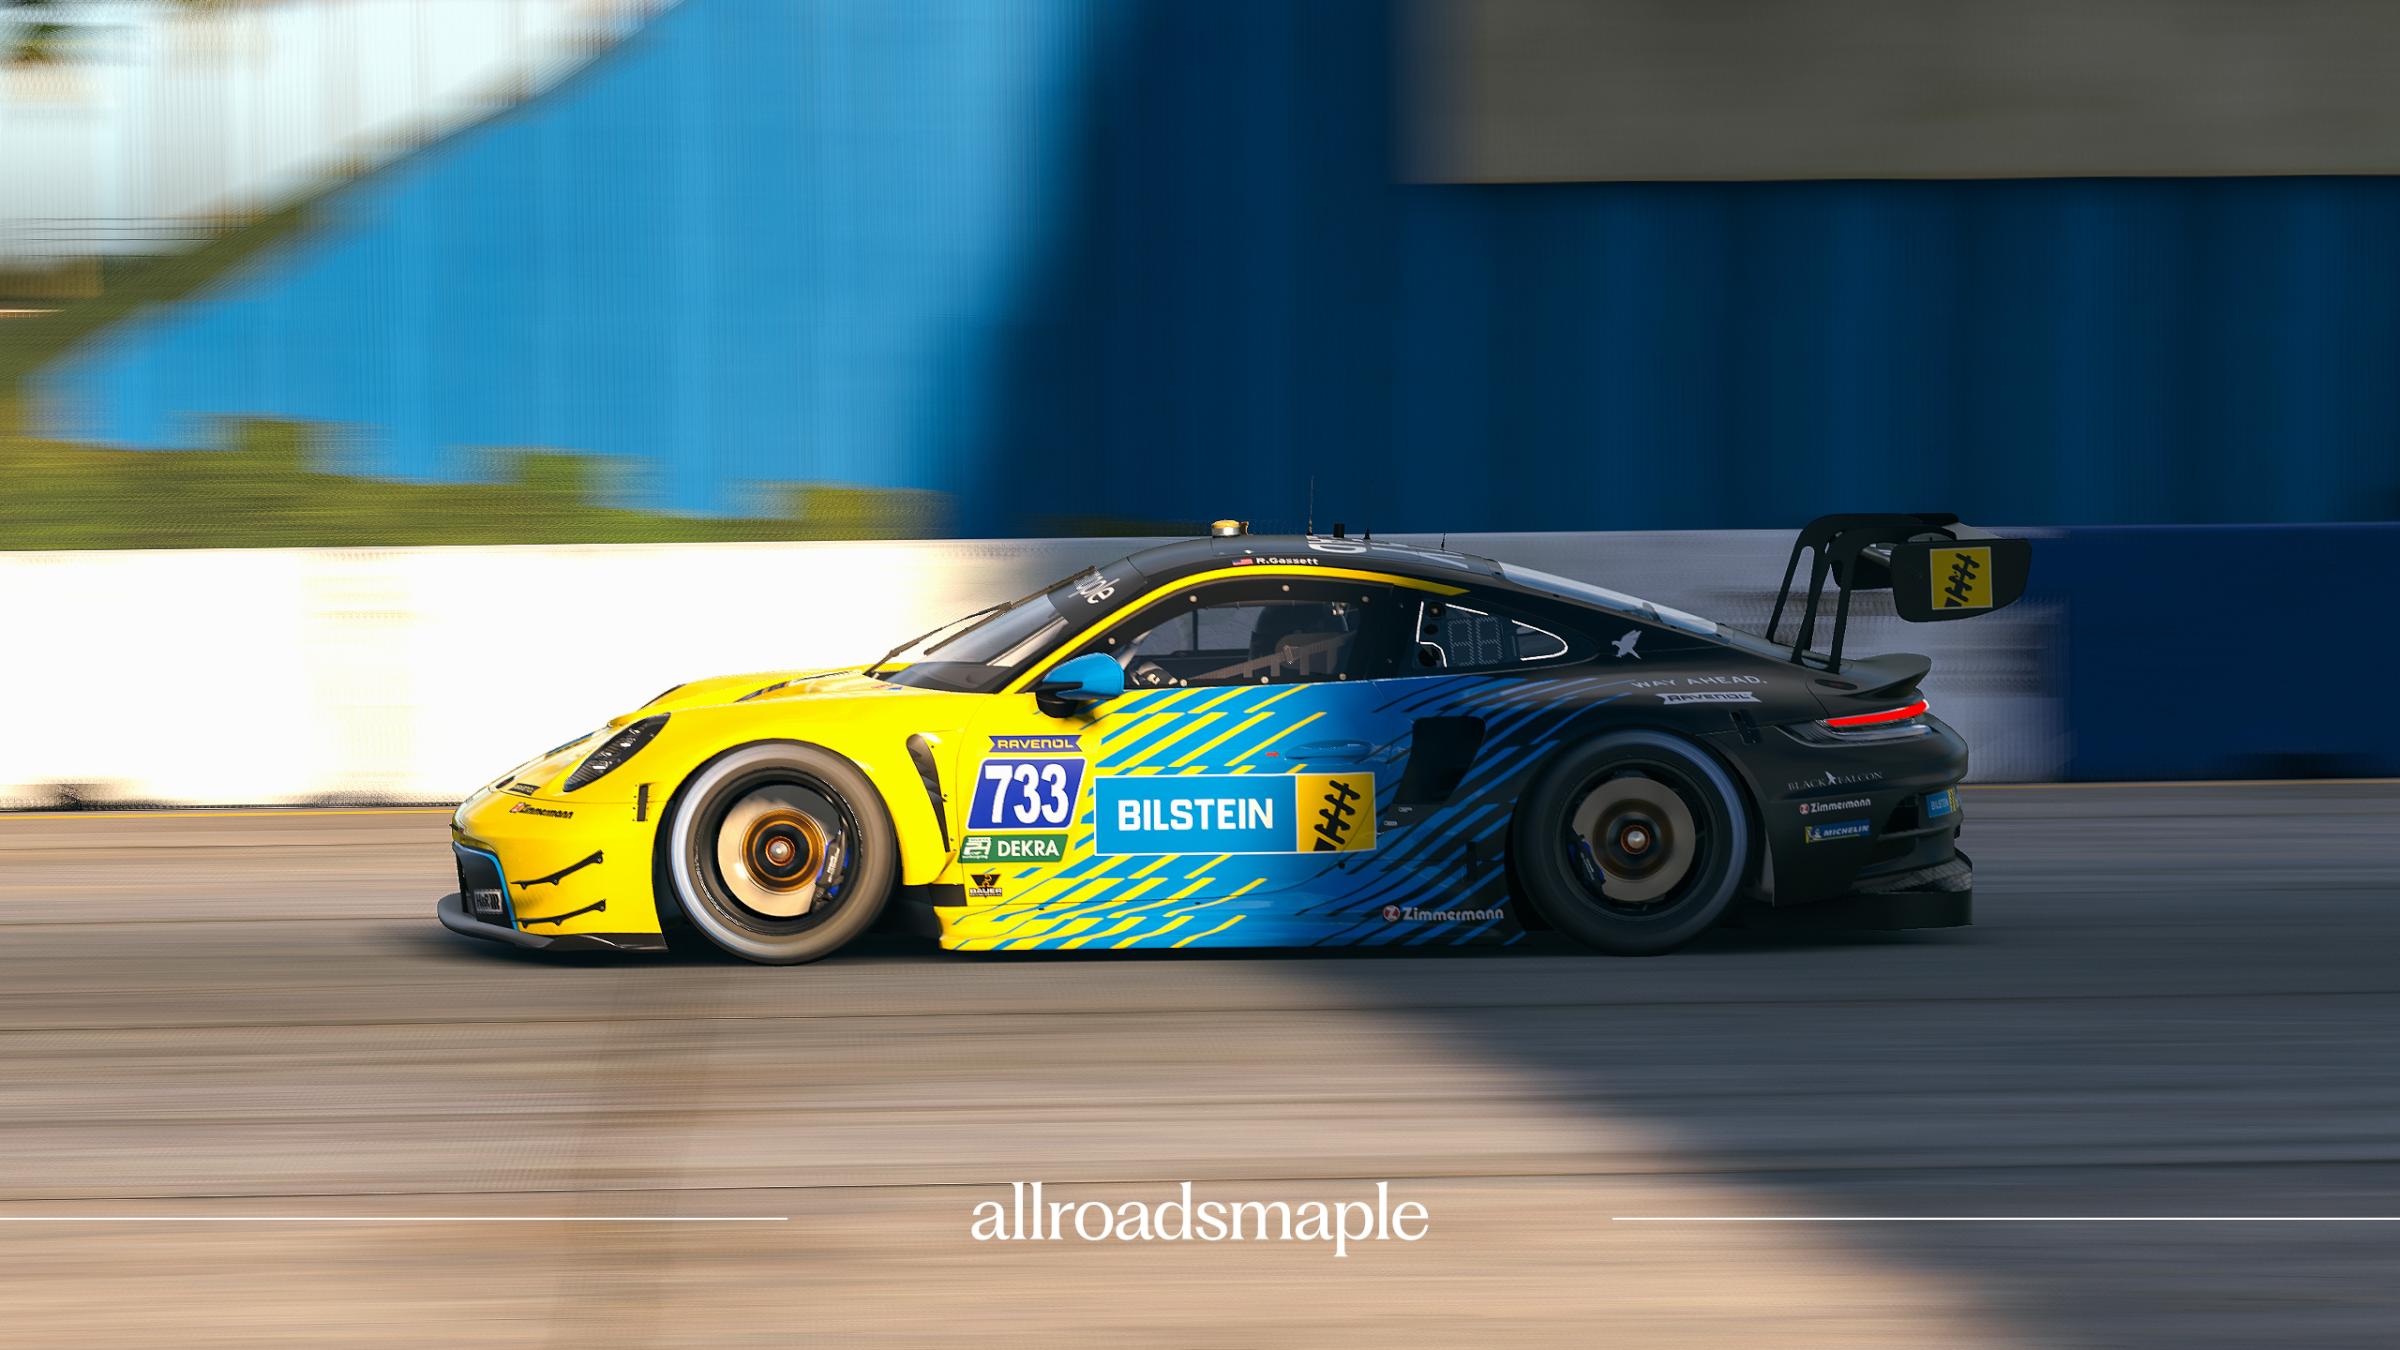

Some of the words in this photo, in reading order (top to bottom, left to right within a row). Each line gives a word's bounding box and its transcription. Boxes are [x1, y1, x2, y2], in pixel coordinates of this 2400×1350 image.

[1256, 557, 1319, 565] R.Gassett
[1632, 680, 1676, 688] WAY
[1687, 675, 1768, 685] AHEAD.
[1666, 693, 1752, 702] RAVENOL
[997, 739, 1075, 749] RAVENOL
[1788, 779, 1826, 791] BLACK
[1838, 772, 1882, 784] FALCON
[985, 763, 1069, 824] 733
[1810, 798, 1871, 813] Zimmermann
[1118, 798, 1273, 831] BILSTEIN
[1823, 825, 1869, 836] MICHELIN
[997, 840, 1060, 857] DEKRA
[1402, 907, 1504, 921] Zimmermann
